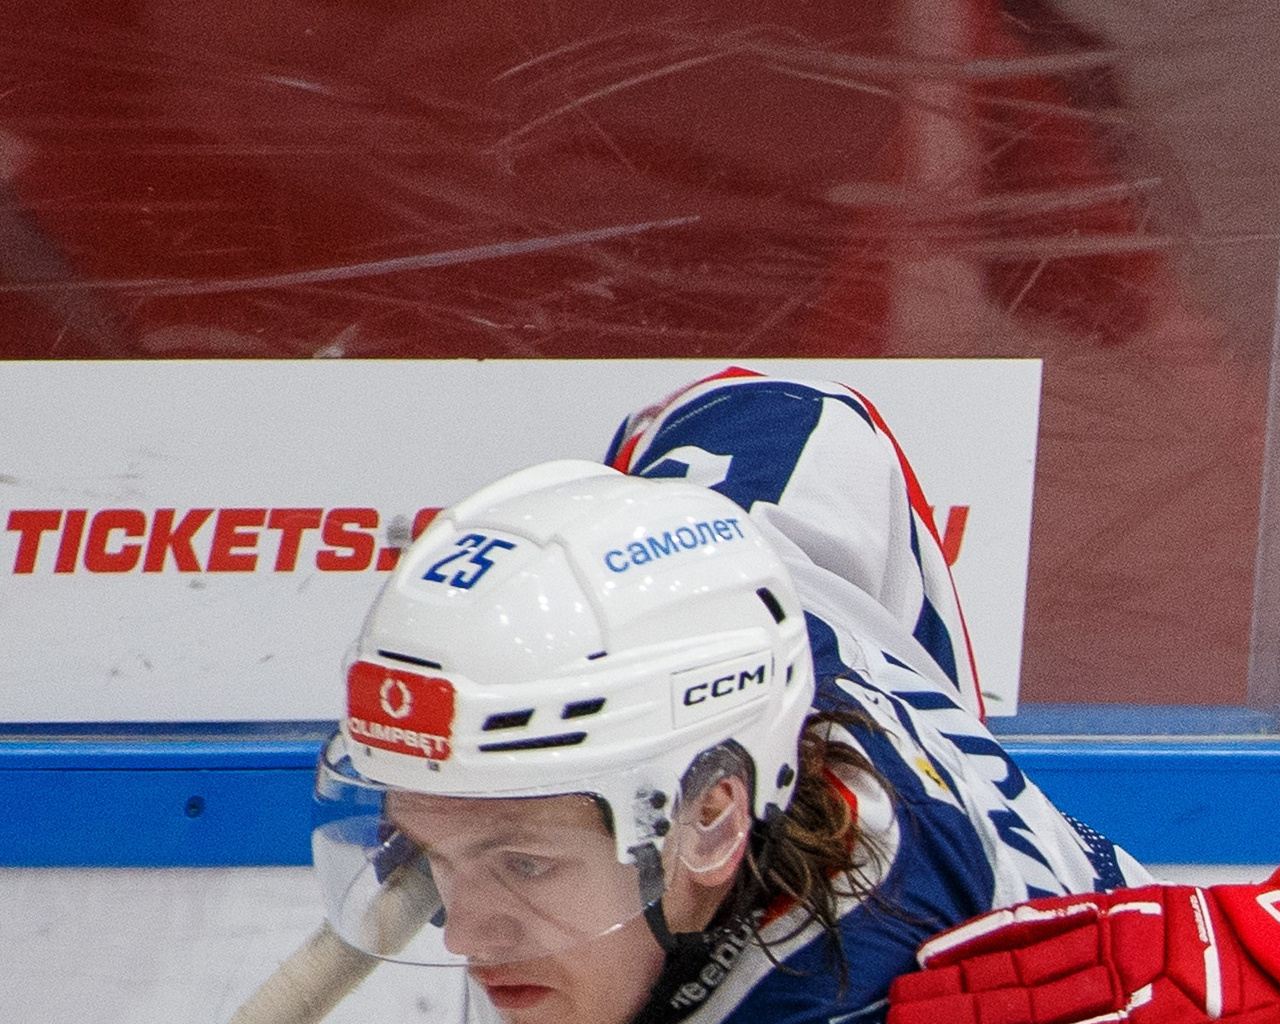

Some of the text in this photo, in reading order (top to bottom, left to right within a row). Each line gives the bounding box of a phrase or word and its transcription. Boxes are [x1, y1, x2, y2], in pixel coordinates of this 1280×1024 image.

[6, 507, 445, 573] TICKETS.
[422, 533, 517, 590] 25
[604, 517, 745, 573] самолет
[682, 665, 765, 707] CCM
